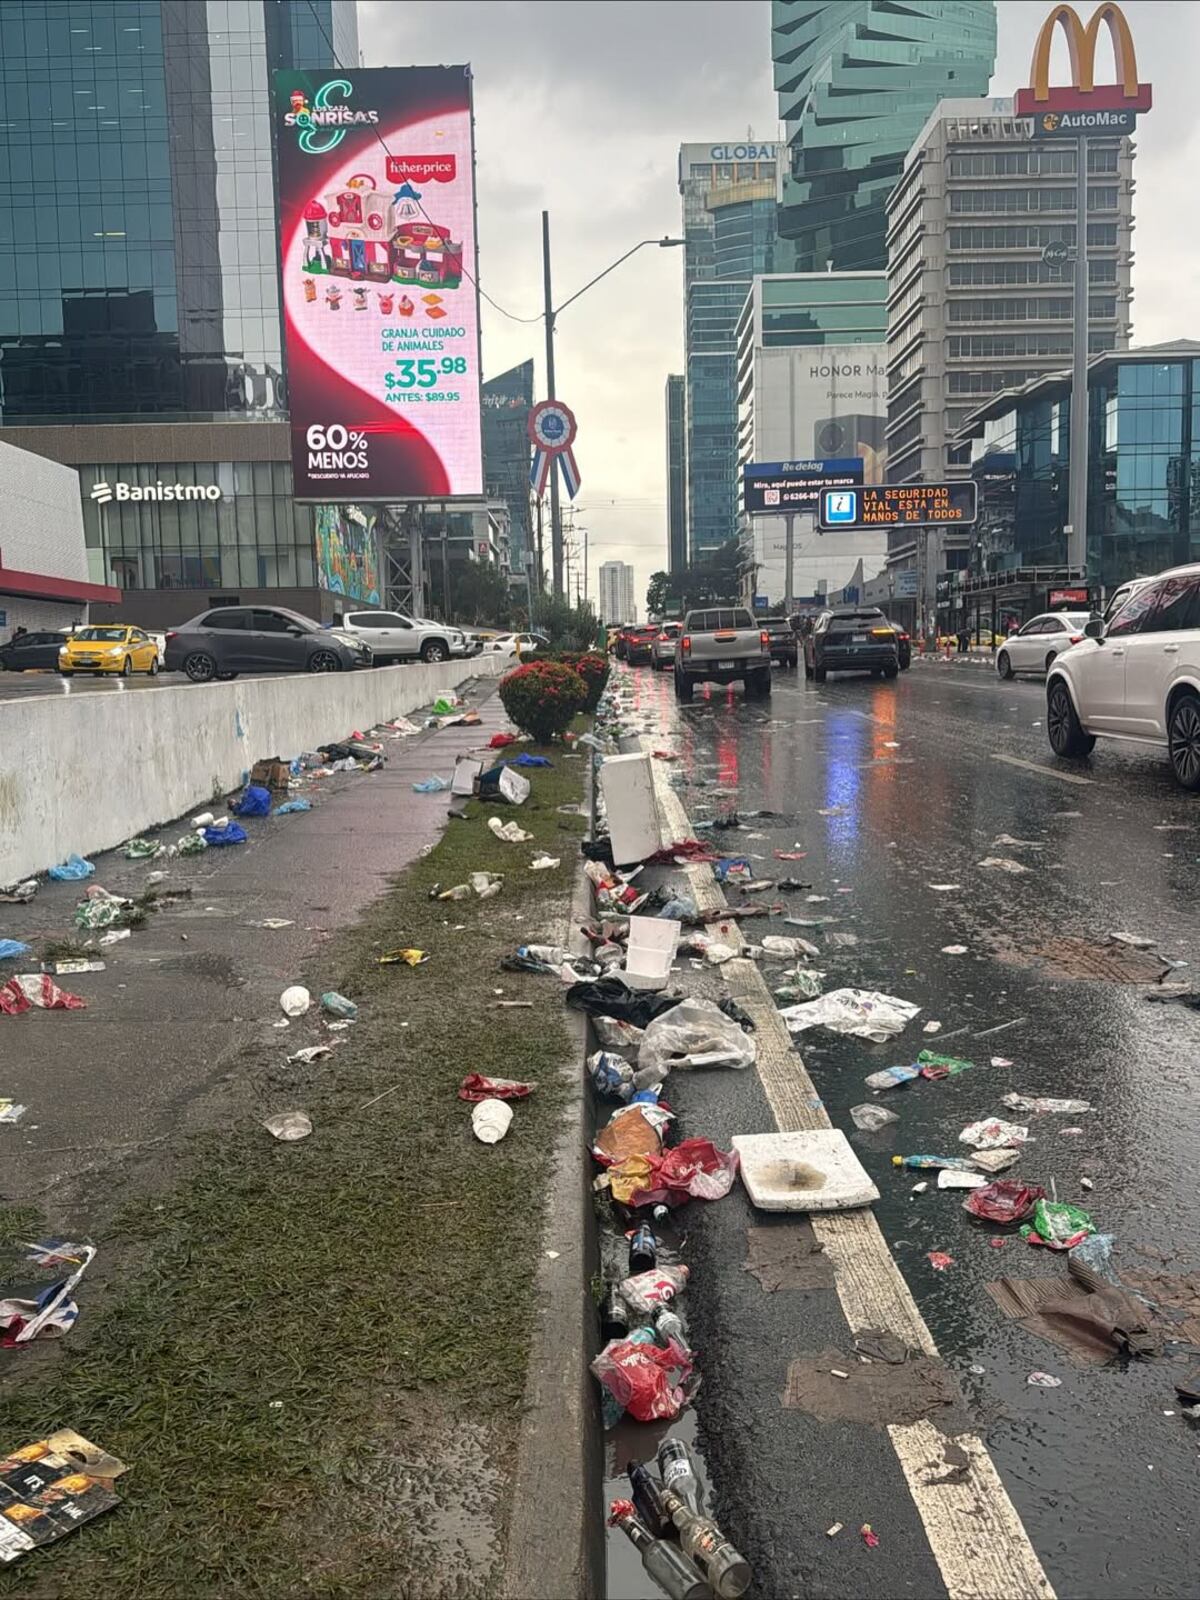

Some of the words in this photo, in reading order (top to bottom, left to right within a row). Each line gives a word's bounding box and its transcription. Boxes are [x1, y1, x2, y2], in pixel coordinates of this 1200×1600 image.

[284, 110, 379, 126] SONRISAS
[1060, 112, 1128, 127] AutoMac
[711, 145, 777, 161] GLOBAL
[390, 160, 452, 175] fisher-price
[381, 328, 419, 339] GRANJA
[422, 327, 466, 338] CUIDADO
[382, 341, 394, 351] DE
[397, 340, 444, 351] ANIMALES
[384, 357, 467, 390] $35.98
[809, 365, 861, 378] HONOR
[866, 365, 888, 376] Ma
[384, 392, 423, 402] ANTES:
[425, 392, 460, 402] $89.95
[826, 391, 853, 400] Parece
[306, 424, 368, 450] 60%
[308, 451, 368, 469] MENOS
[115, 480, 221, 501] Banistmo
[753, 481, 771, 489] Mira,
[786, 480, 807, 489] puede
[807, 479, 824, 487] estar
[825, 478, 832, 486] tu
[863, 490, 878, 501] LA
[885, 488, 949, 500] SEGURIDAD
[863, 500, 891, 512] VIAL
[898, 499, 927, 510] ESTA
[934, 499, 949, 508] EN
[863, 511, 899, 522] MANOS
[905, 510, 920, 520] DE
[928, 508, 962, 519] TODOS
